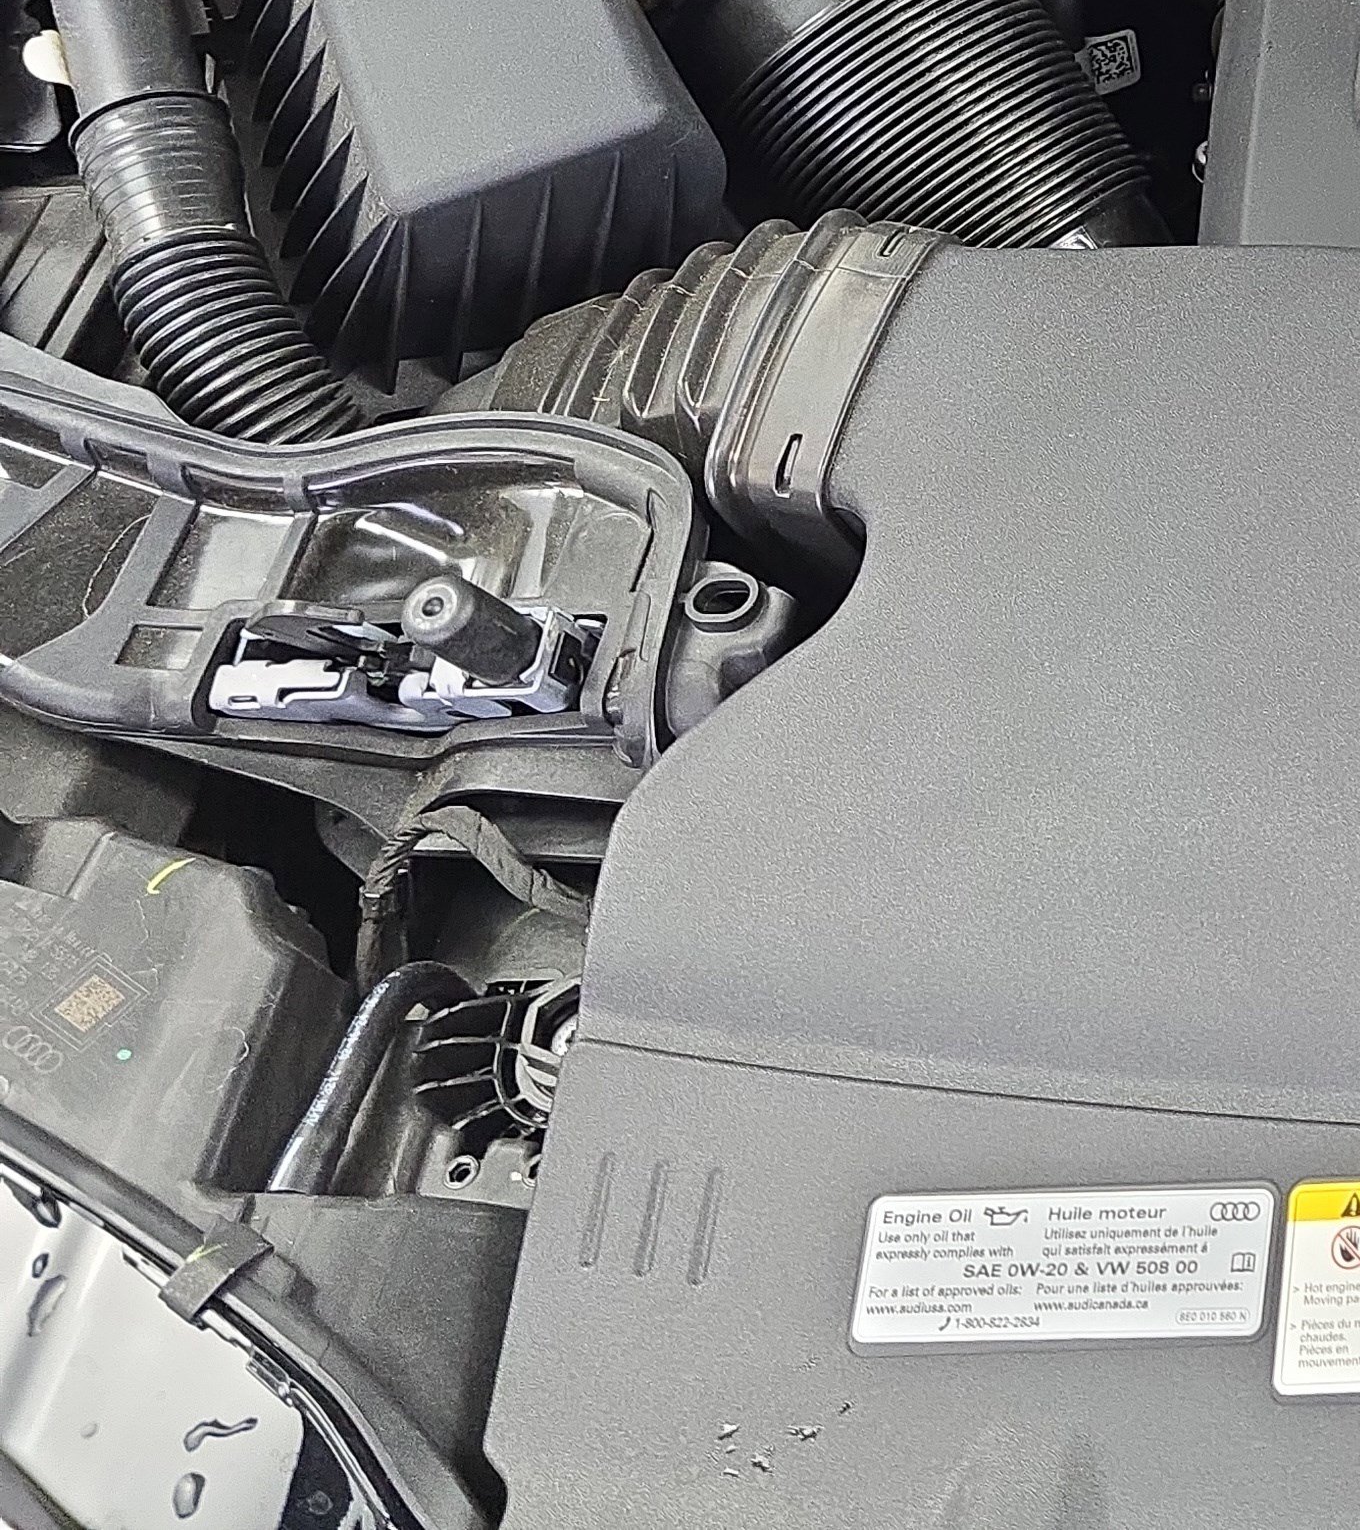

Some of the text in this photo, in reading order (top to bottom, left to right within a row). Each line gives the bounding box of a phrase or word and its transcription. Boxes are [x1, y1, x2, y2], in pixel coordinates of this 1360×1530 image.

[883, 1209, 972, 1226] Engine Oil
[1048, 1207, 1167, 1221] Huile moteur
[878, 1230, 976, 1244] Use only oil that
[1044, 1227, 1087, 1240] Utilisez
[1090, 1226, 1162, 1241] uniquement
[1164, 1226, 1179, 1238] de
[875, 1246, 1014, 1261] expressly complies with
[1042, 1244, 1062, 1258] qui
[1064, 1243, 1111, 1256] satisfait
[1114, 1242, 1198, 1257] expressément
[963, 1260, 1198, 1278] SAE 0W-20 & VW 508 00
[869, 1283, 1023, 1299] For a list of approved oils:
[1036, 1282, 1064, 1295] Pour
[1067, 1283, 1089, 1294] une
[1093, 1281, 1117, 1293] liste
[1304, 1282, 1323, 1293] Hot
[1033, 1298, 1149, 1312] www.audicanada.ca
[1303, 1294, 1343, 1307] Moving
[1337, 1318, 1351, 1328] du
[1300, 1331, 1347, 1343] chaudes.
[1335, 1345, 1349, 1354] en
